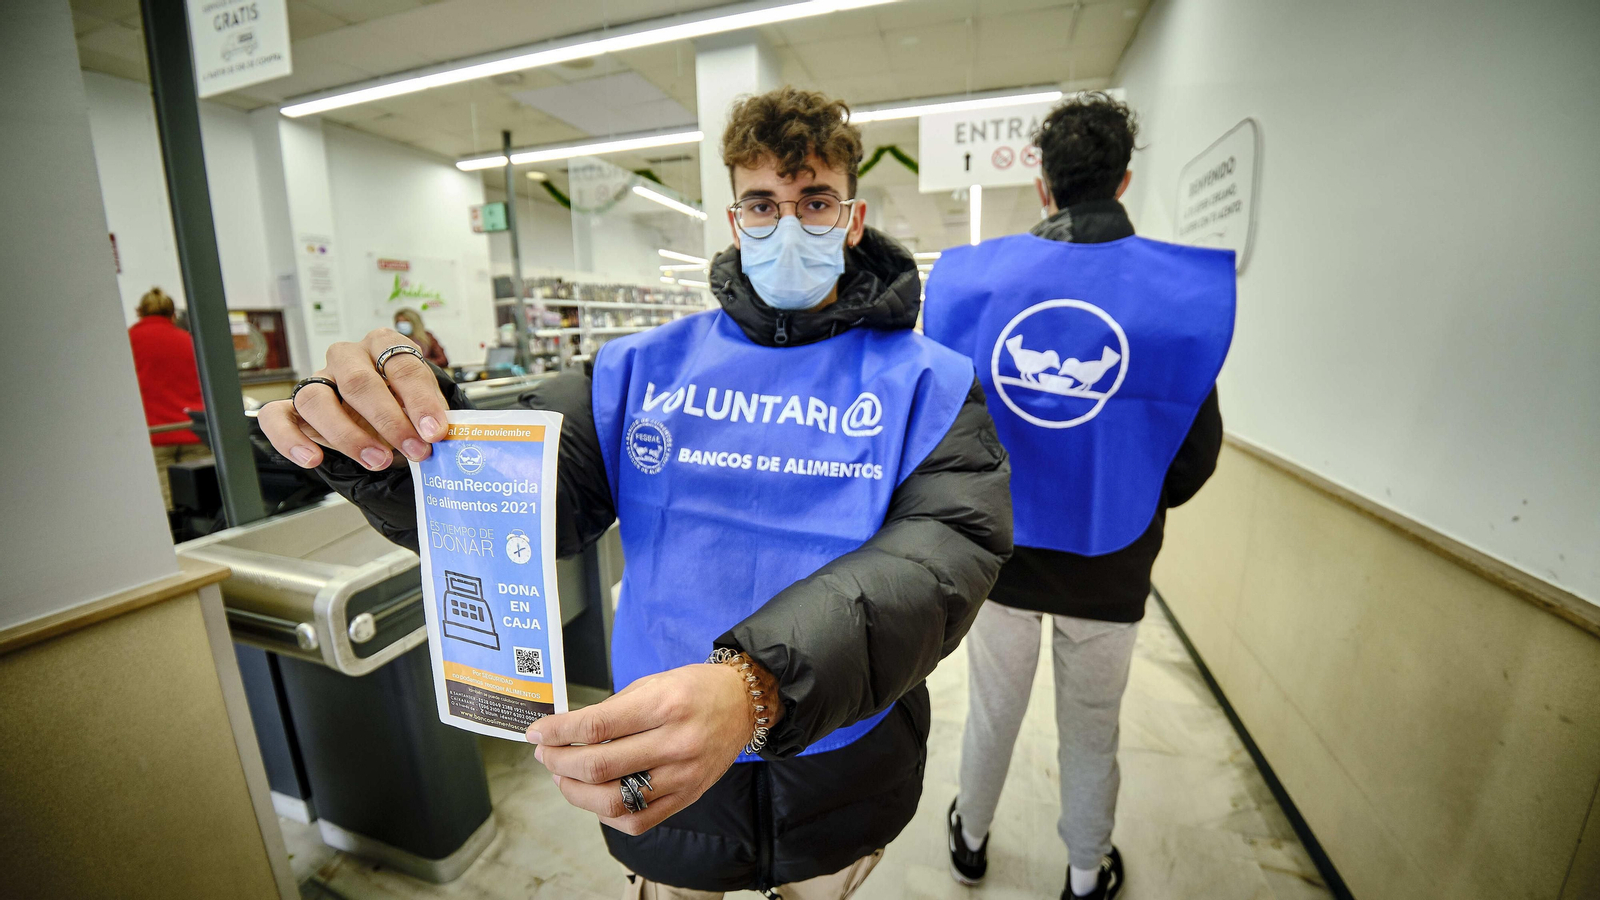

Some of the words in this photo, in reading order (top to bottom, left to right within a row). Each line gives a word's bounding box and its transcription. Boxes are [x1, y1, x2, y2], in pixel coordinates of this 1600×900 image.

[213, 3, 258, 31] GRATIS
[641, 382, 883, 437] VOLUNTARI@
[448, 427, 456, 436] al
[458, 427, 470, 436] 25
[471, 428, 482, 436] de
[484, 428, 531, 437] noviembre
[678, 448, 752, 470] BANCOS
[756, 455, 781, 471] DE
[783, 458, 883, 480] ALIMENTOS
[423, 473, 538, 497] LaGranRecogida
[426, 494, 438, 506] de
[439, 496, 498, 513] alimentos
[500, 501, 536, 514] 2021
[430, 520, 440, 532] ES
[441, 522, 476, 538] TIEMPO
[479, 528, 494, 540] DE
[431, 531, 495, 558] DONAR
[498, 583, 540, 597] DONA
[510, 600, 530, 613] EN
[502, 616, 541, 630] CAJA
[482, 672, 513, 685] SEGURIDAD
[506, 687, 541, 699] ALIMENTOS
